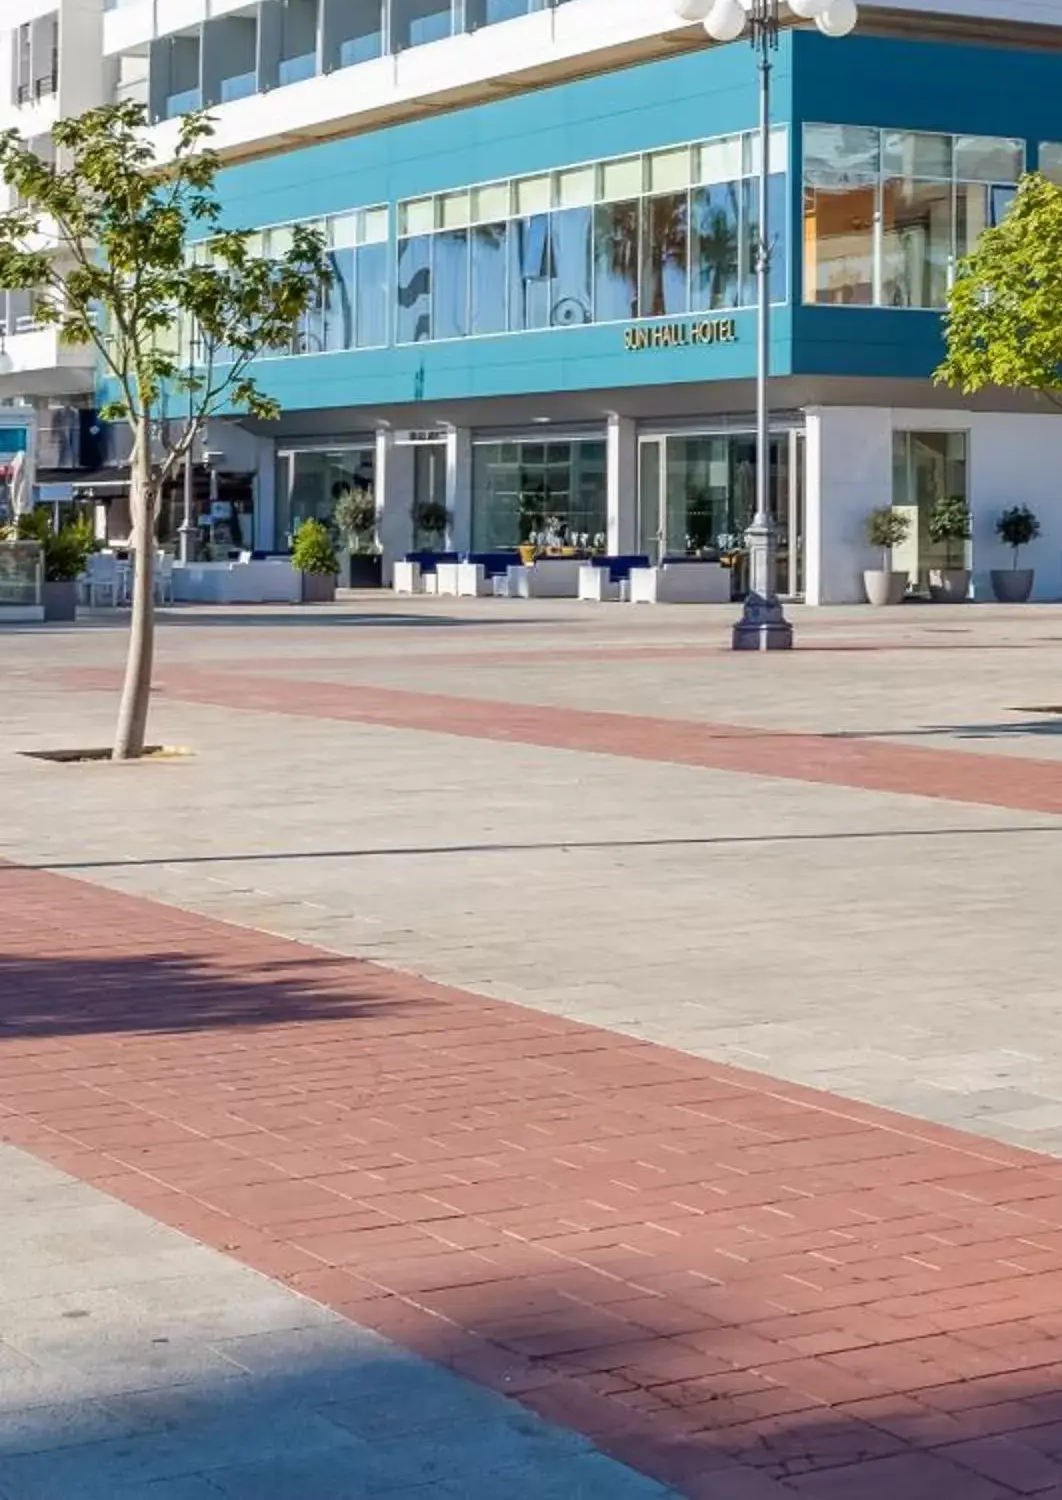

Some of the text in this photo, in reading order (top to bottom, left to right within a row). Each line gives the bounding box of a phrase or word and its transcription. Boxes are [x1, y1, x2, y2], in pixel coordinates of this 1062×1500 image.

[624, 318, 738, 350] SUN HALL HOTEL
